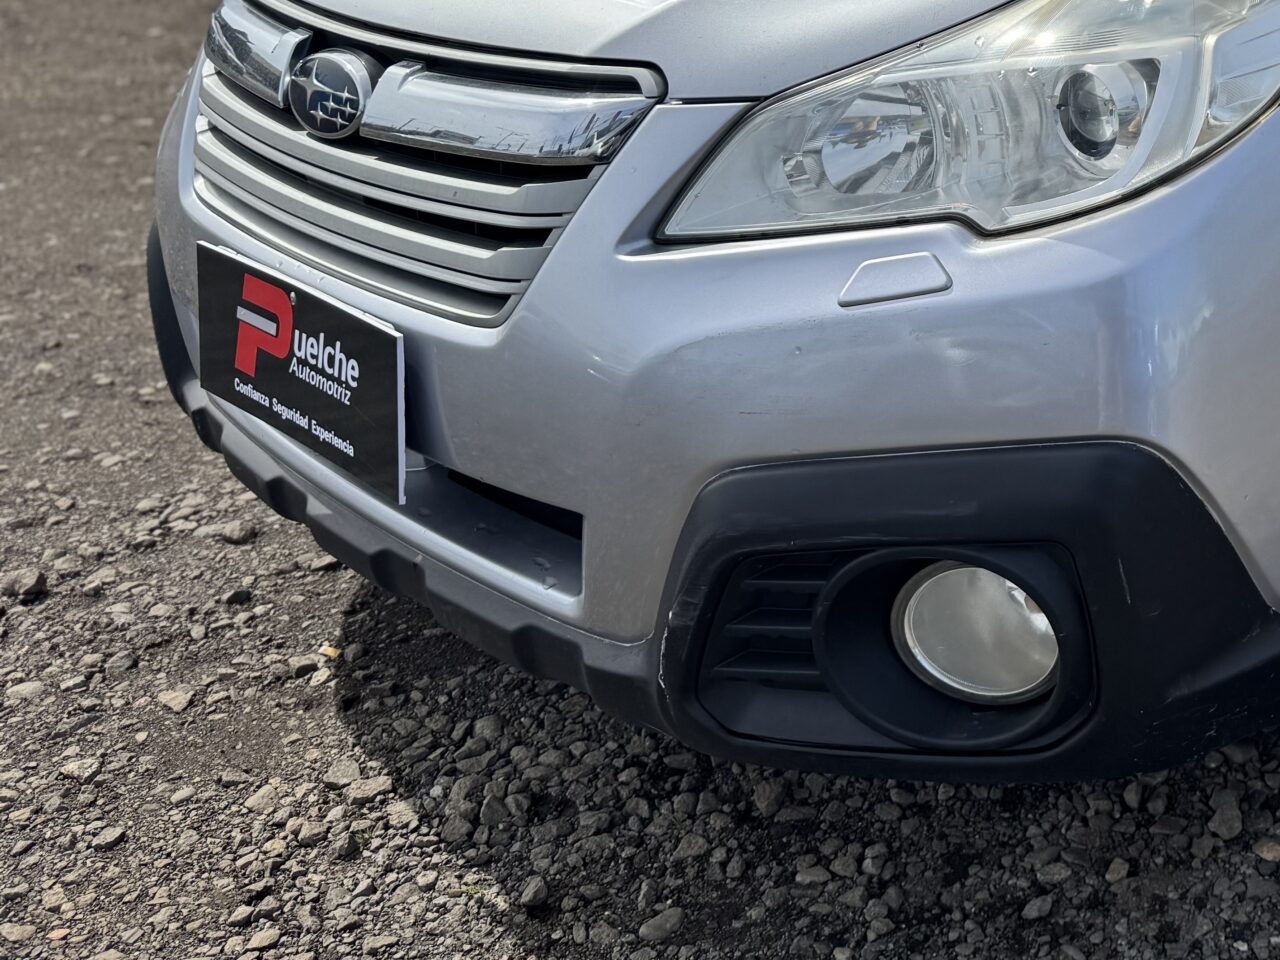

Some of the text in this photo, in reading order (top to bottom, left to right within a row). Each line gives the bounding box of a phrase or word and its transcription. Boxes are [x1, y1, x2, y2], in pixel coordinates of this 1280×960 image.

[234, 273, 360, 387] Puelche
[234, 377, 354, 457] Confianza Seguridad Experiencia
[289, 357, 352, 406] Automotriz
